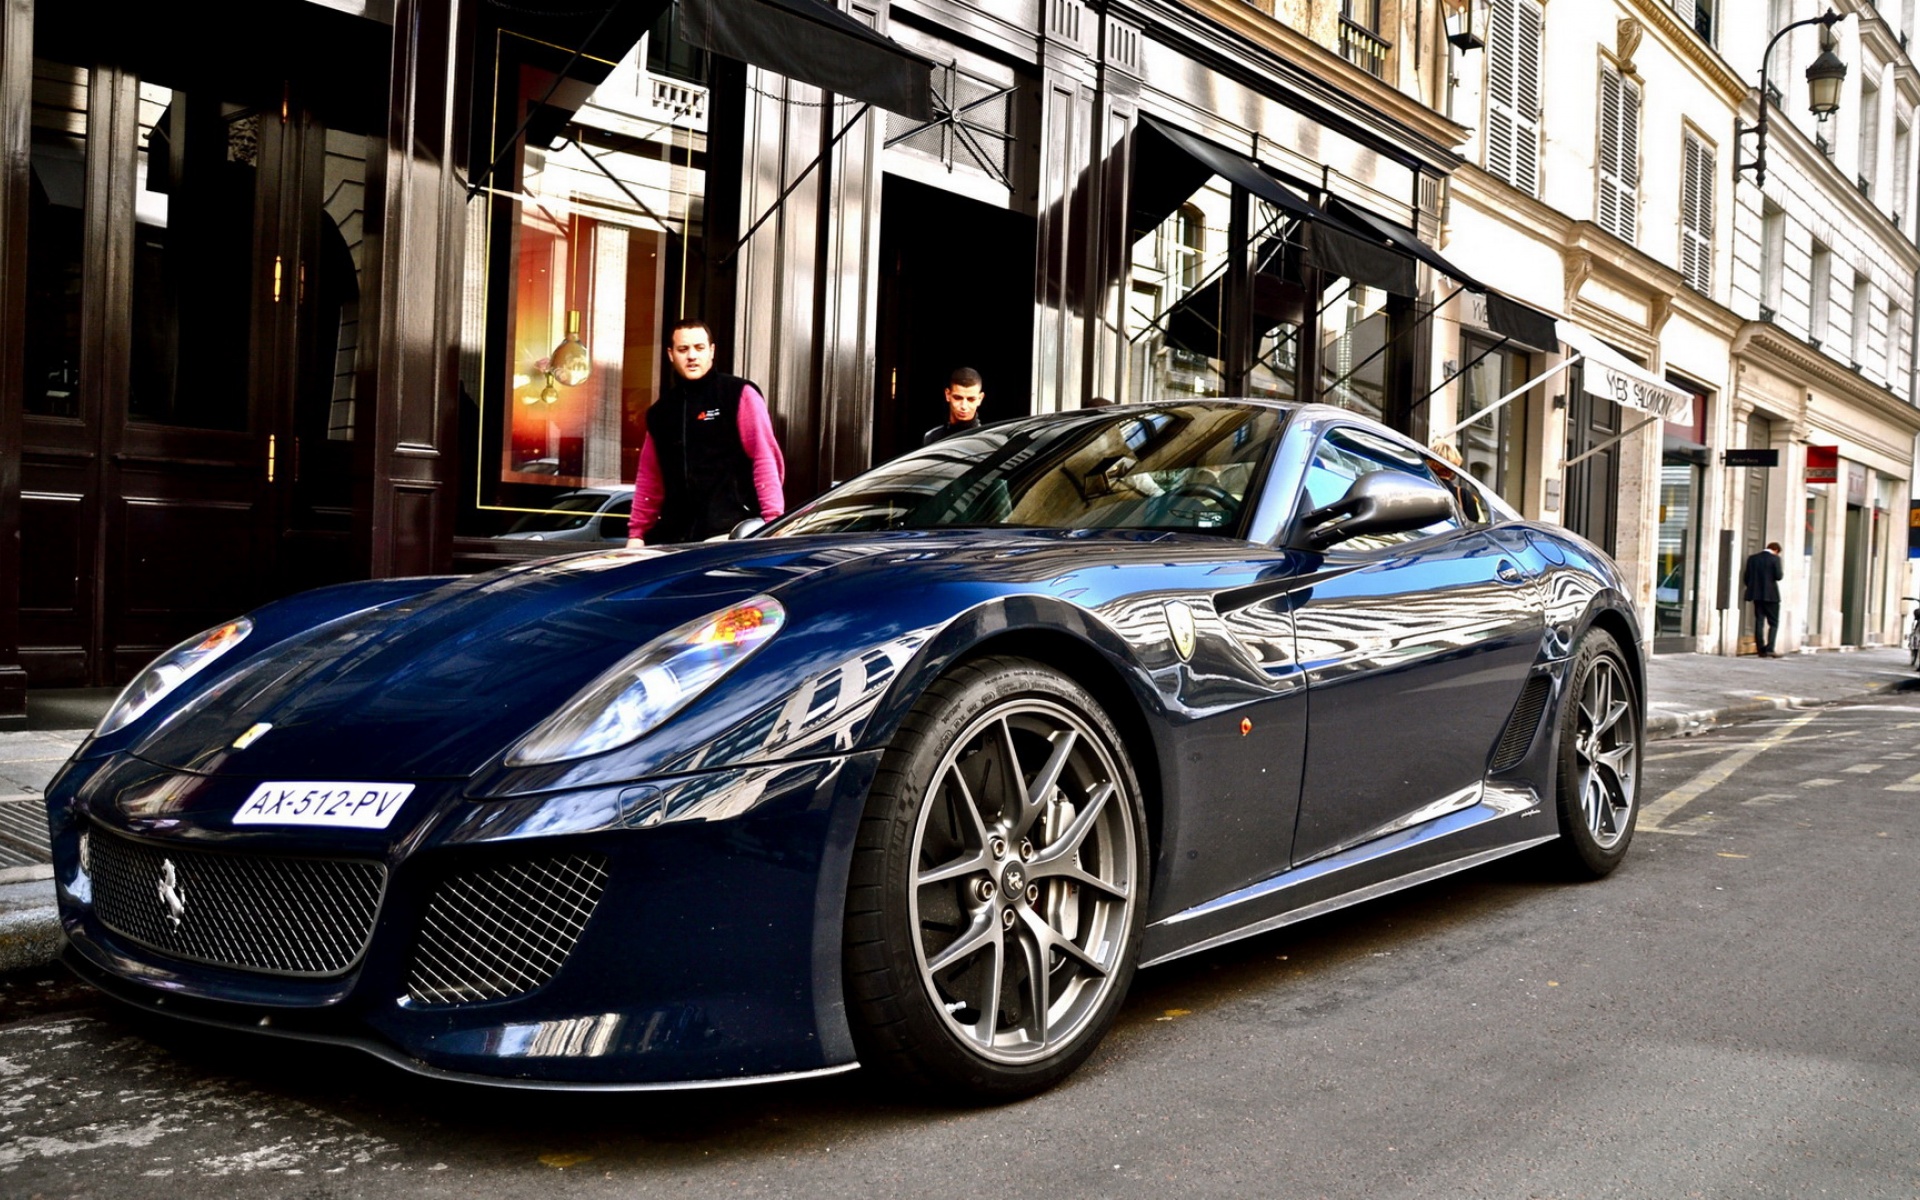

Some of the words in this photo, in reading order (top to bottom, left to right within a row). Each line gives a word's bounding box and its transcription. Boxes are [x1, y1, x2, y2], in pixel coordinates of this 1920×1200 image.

[1473, 300, 1488, 323] YVE
[1607, 370, 1628, 402] YVES
[245, 790, 402, 817] AX-512-PV
